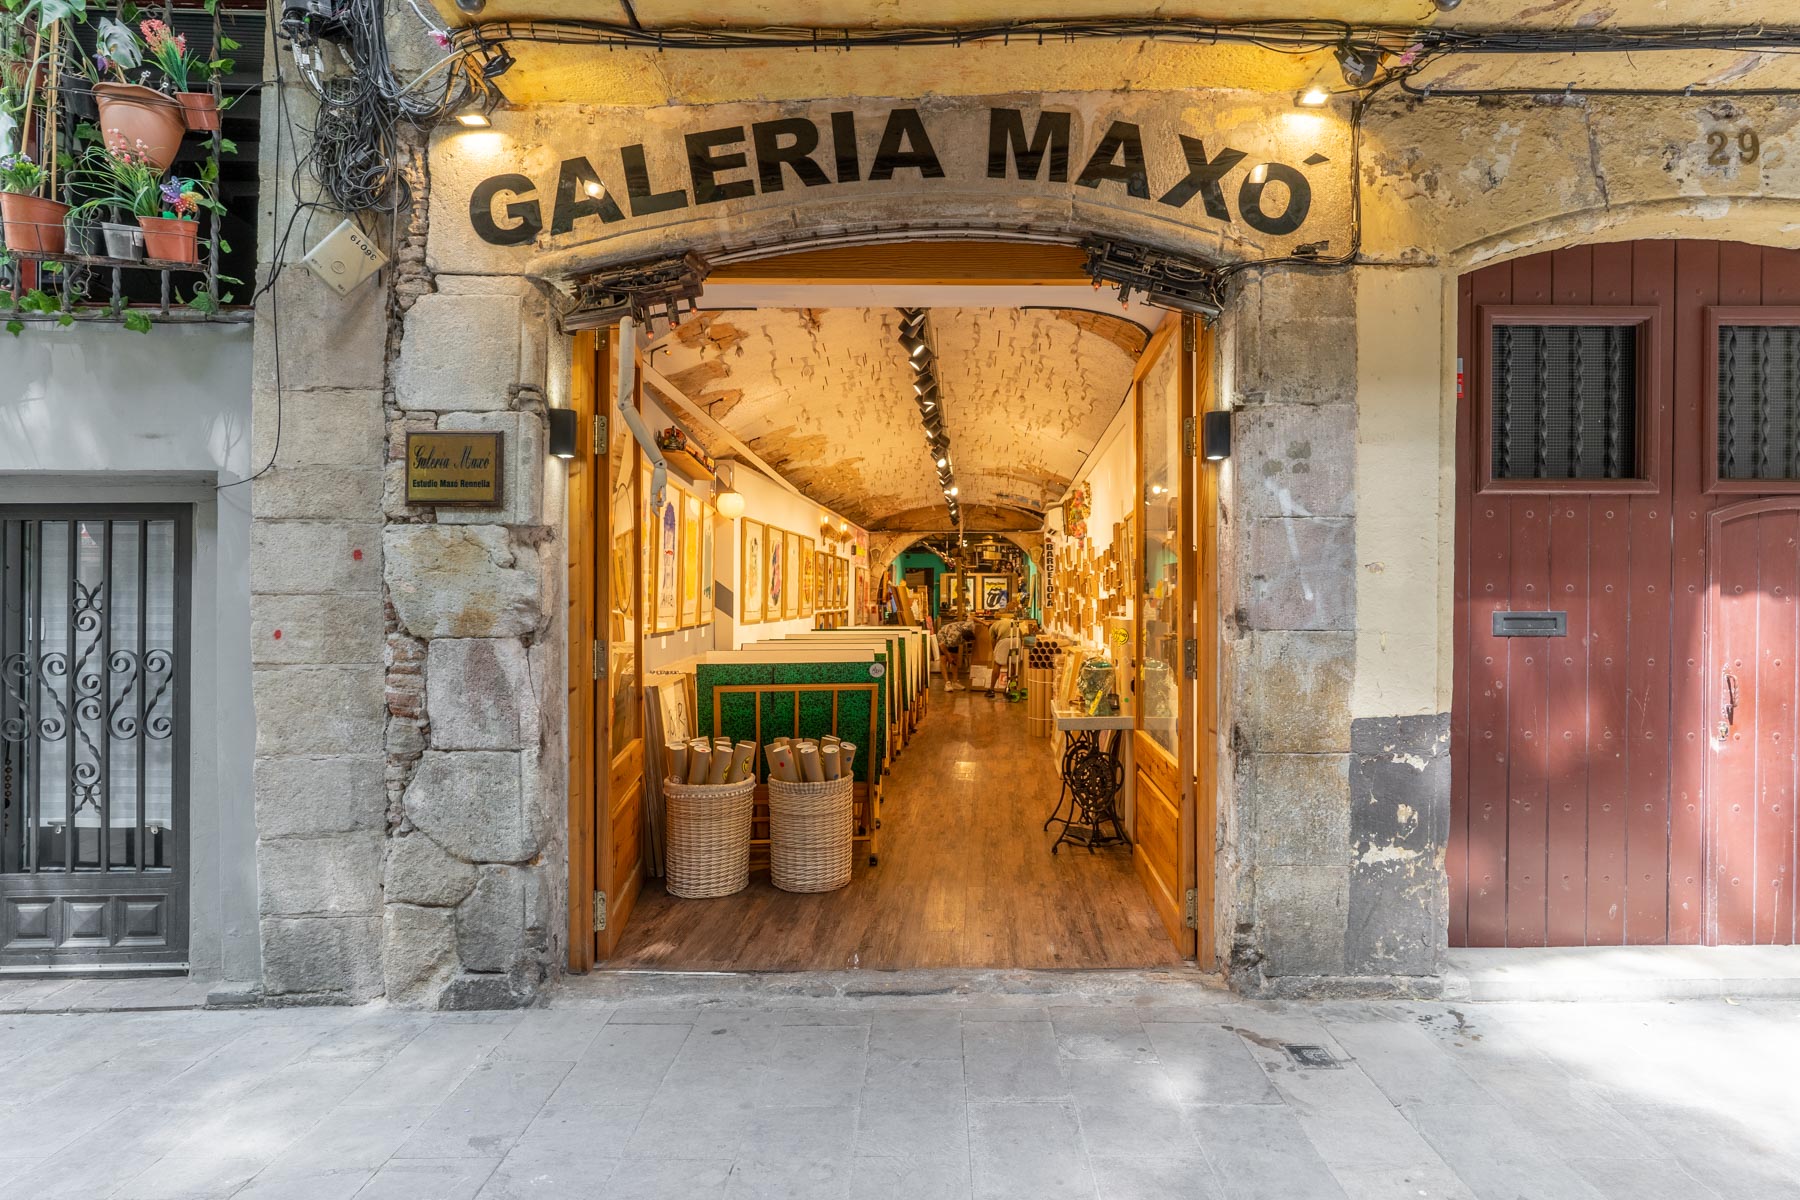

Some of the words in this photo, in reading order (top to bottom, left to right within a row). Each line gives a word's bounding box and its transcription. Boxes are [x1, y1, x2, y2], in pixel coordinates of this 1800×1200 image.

[1707, 128, 1760, 165] 29
[469, 108, 946, 246] GALERIA
[987, 107, 1331, 236] MAXÓ
[350, 234, 377, 261] 36019
[412, 479, 438, 488] Estudio
